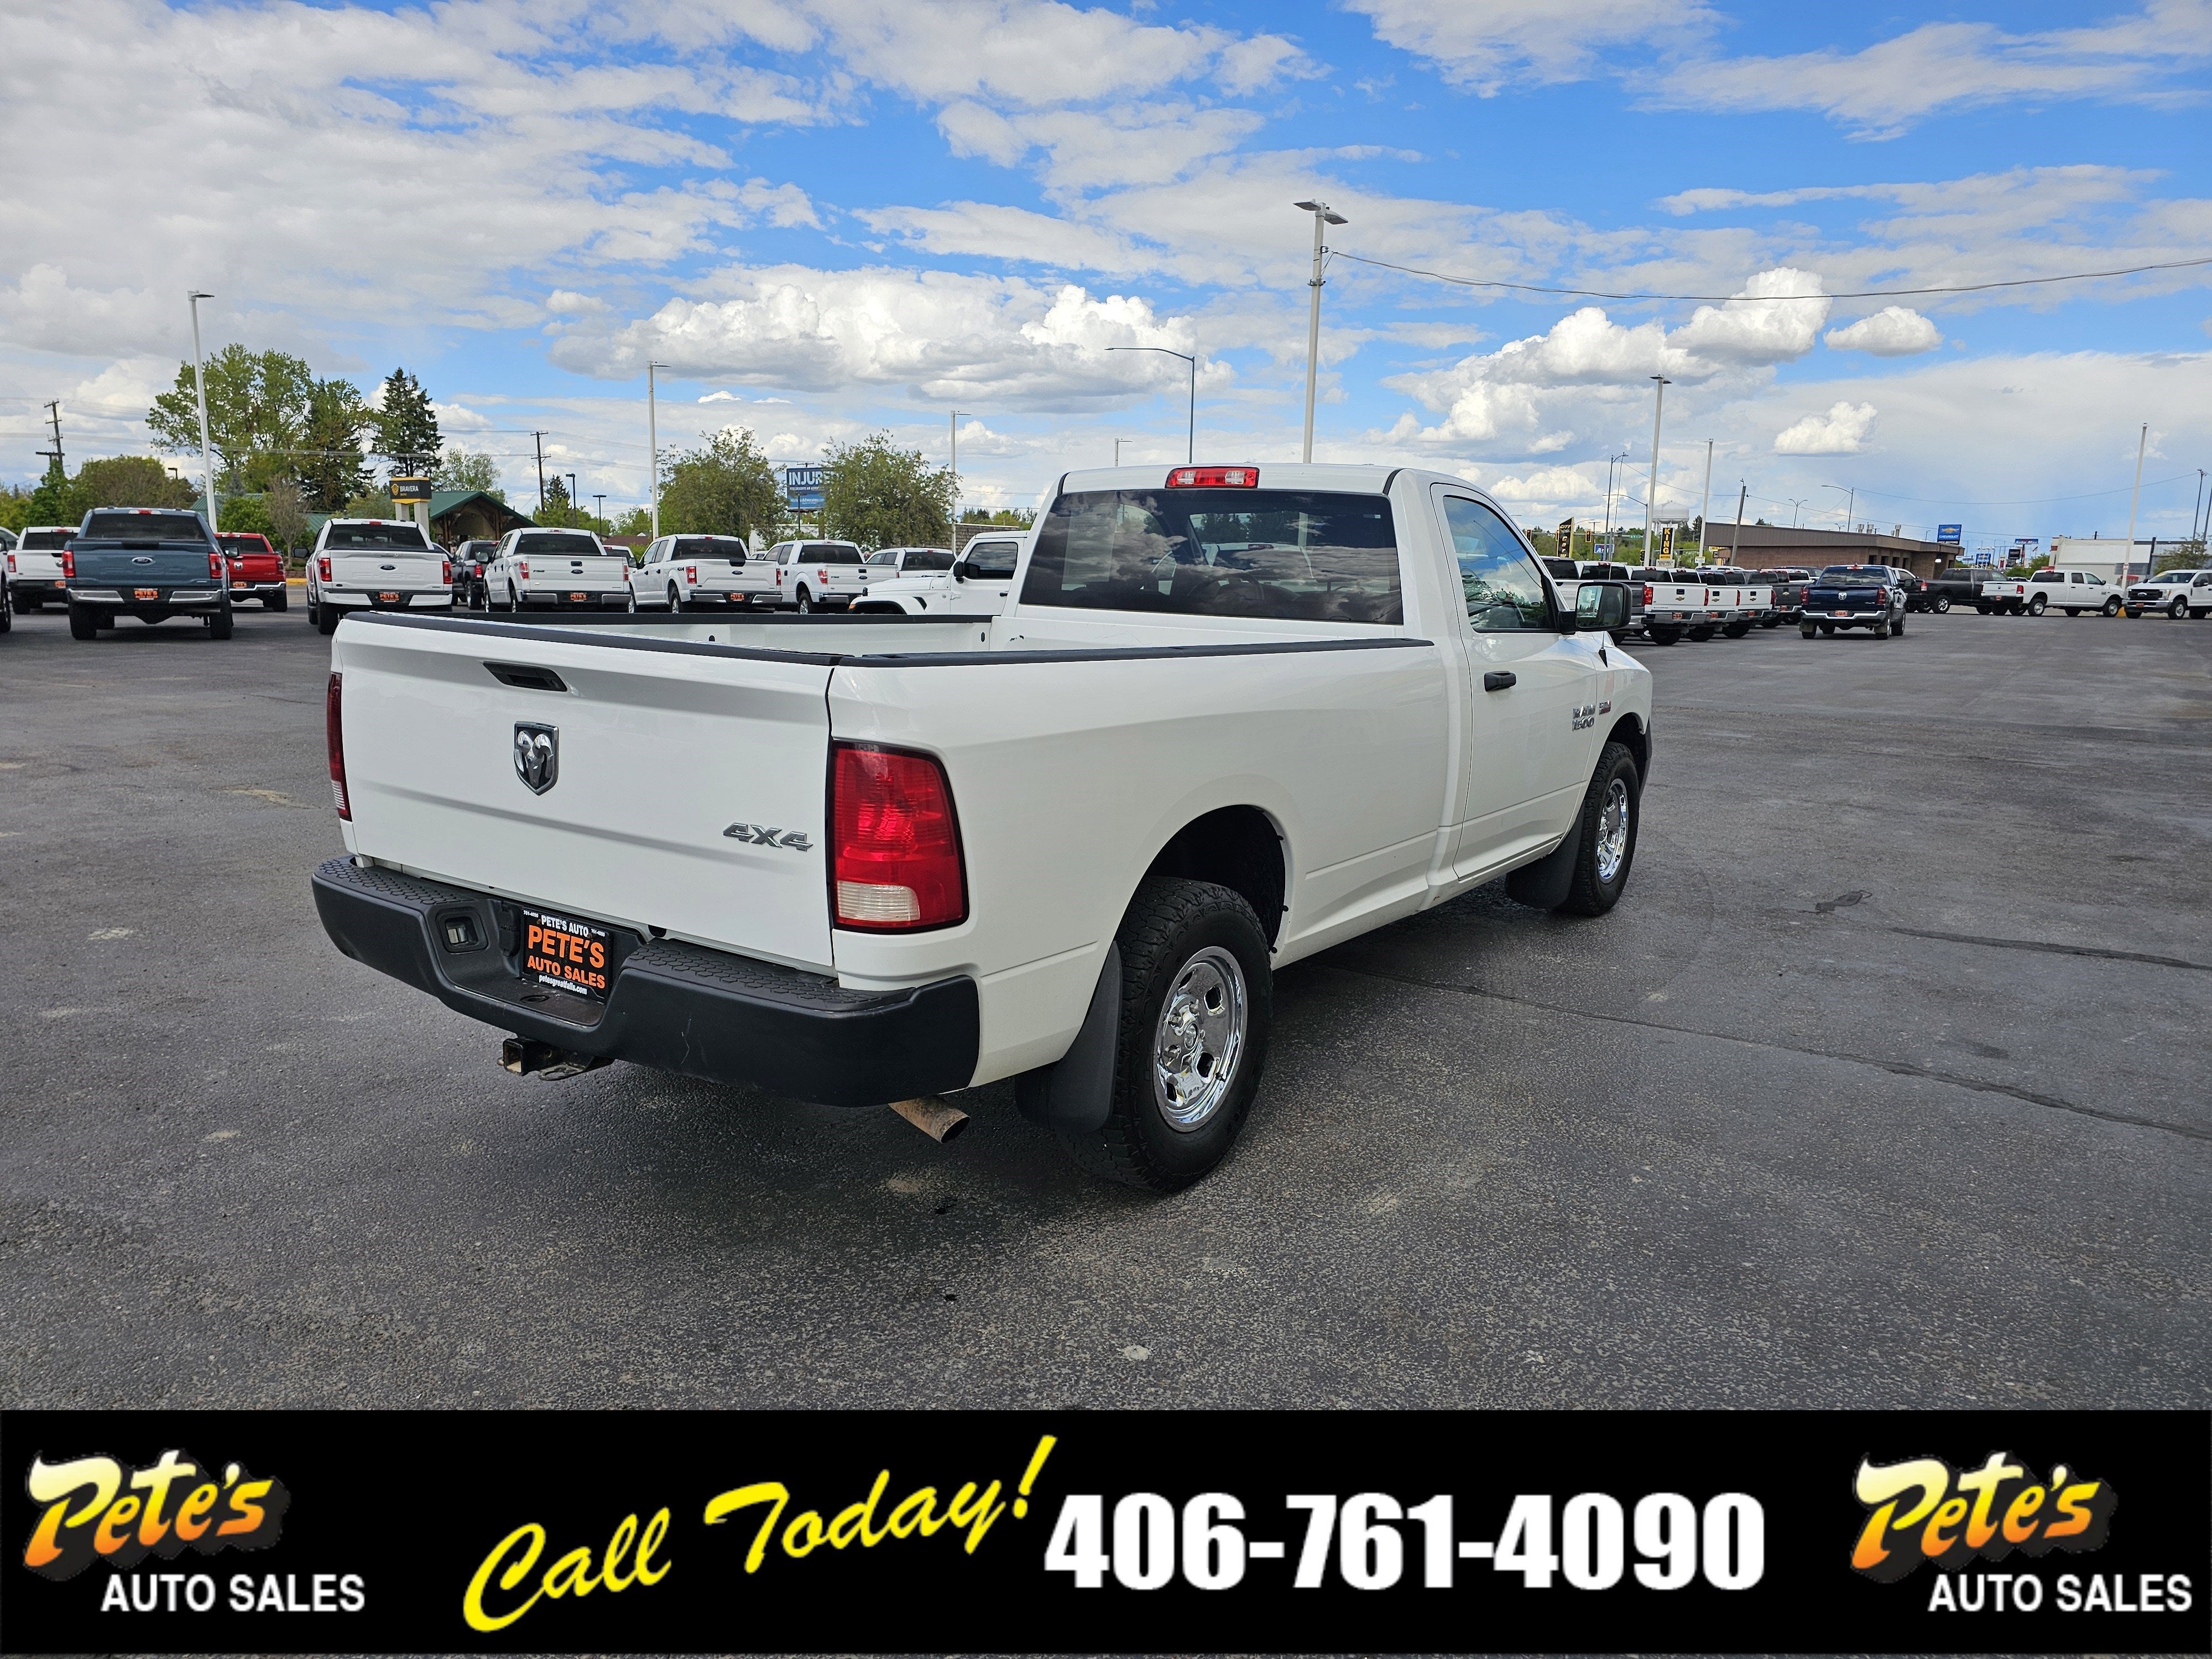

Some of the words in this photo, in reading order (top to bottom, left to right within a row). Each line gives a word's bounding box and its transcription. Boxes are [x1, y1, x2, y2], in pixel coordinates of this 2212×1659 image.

[1663, 528, 1671, 554] KING
[1573, 705, 1595, 719] RAM
[1572, 717, 1594, 732] 1500
[541, 915, 567, 931] PETE'S
[568, 922, 589, 937] AUTO
[528, 925, 605, 968] PETE'S
[527, 955, 561, 976] AUTO
[564, 965, 606, 989] SALES
[539, 974, 587, 995] petesgreatfalls.com
